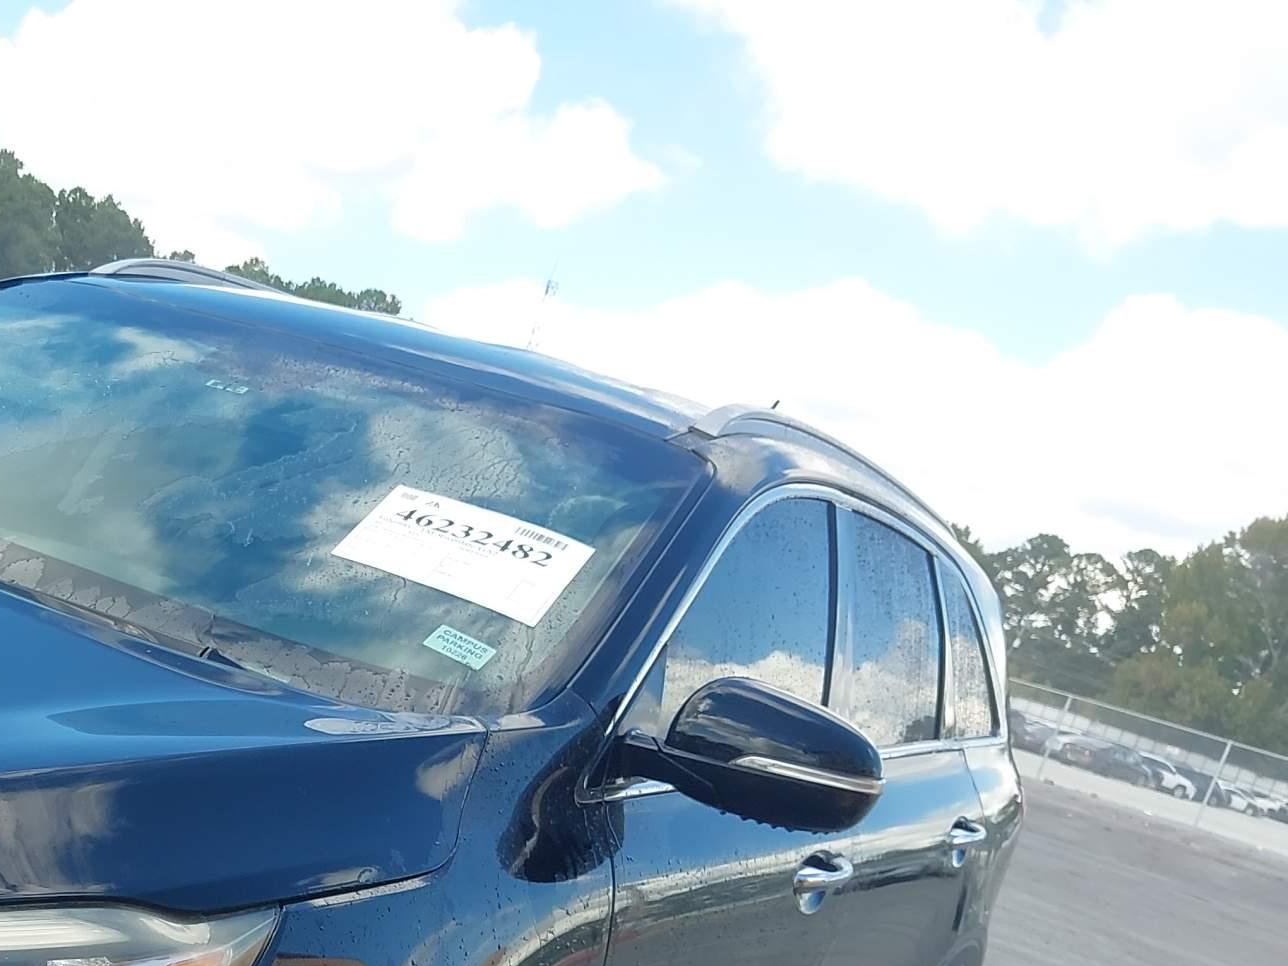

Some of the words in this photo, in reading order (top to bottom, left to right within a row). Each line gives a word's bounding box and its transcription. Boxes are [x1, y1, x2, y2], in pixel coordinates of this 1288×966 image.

[396, 509, 553, 568] 46232482
[436, 634, 483, 660] PARKING
[443, 629, 488, 654] CAMPUS
